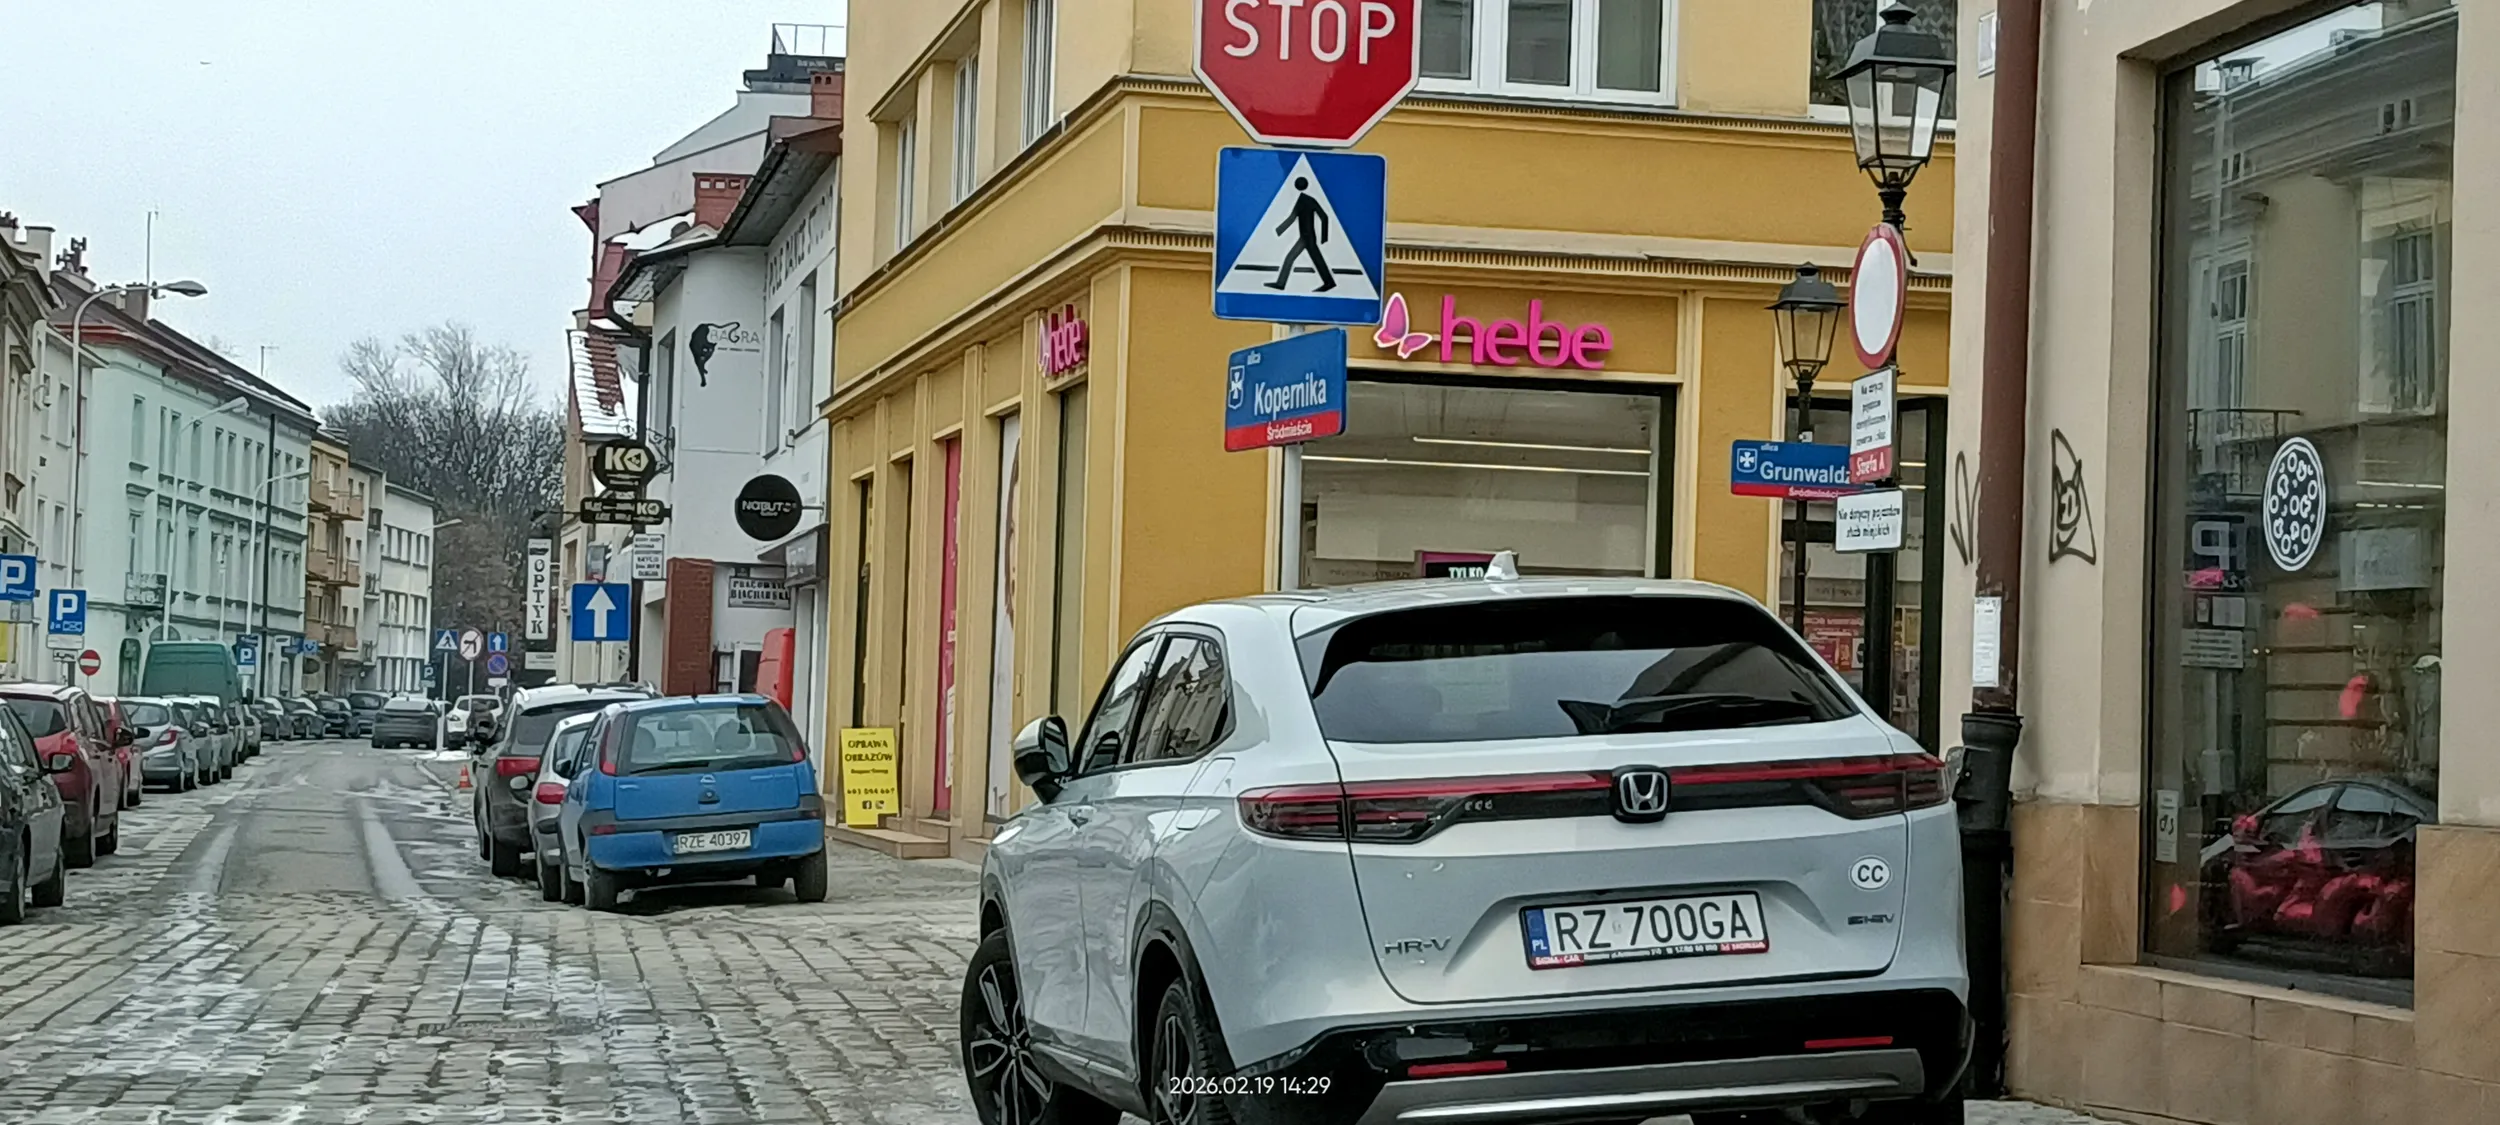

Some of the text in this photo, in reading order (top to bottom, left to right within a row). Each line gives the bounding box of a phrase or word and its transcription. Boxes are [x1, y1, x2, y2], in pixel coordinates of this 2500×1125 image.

[1223, 0, 1395, 64] STOP
[1048, 303, 1087, 375] hebe
[1440, 294, 1613, 369] hebe
[1254, 372, 1327, 420] Kopernika
[1760, 461, 1851, 484] Grunwaldz
[1788, 486, 1840, 498] Śródmieści
[531, 559, 546, 634] OPTYK
[56, 594, 78, 620] P
[240, 647, 252, 663] P
[424, 666, 434, 679] P
[848, 740, 888, 748] OPRAWA
[845, 752, 893, 762] OBRAZÓW
[680, 831, 749, 849] RZE 40397
[1857, 865, 1884, 882] CC
[1554, 899, 1753, 952] RZ 700GA
[1384, 936, 1453, 954] HR-V
[1532, 939, 1548, 951] PL
